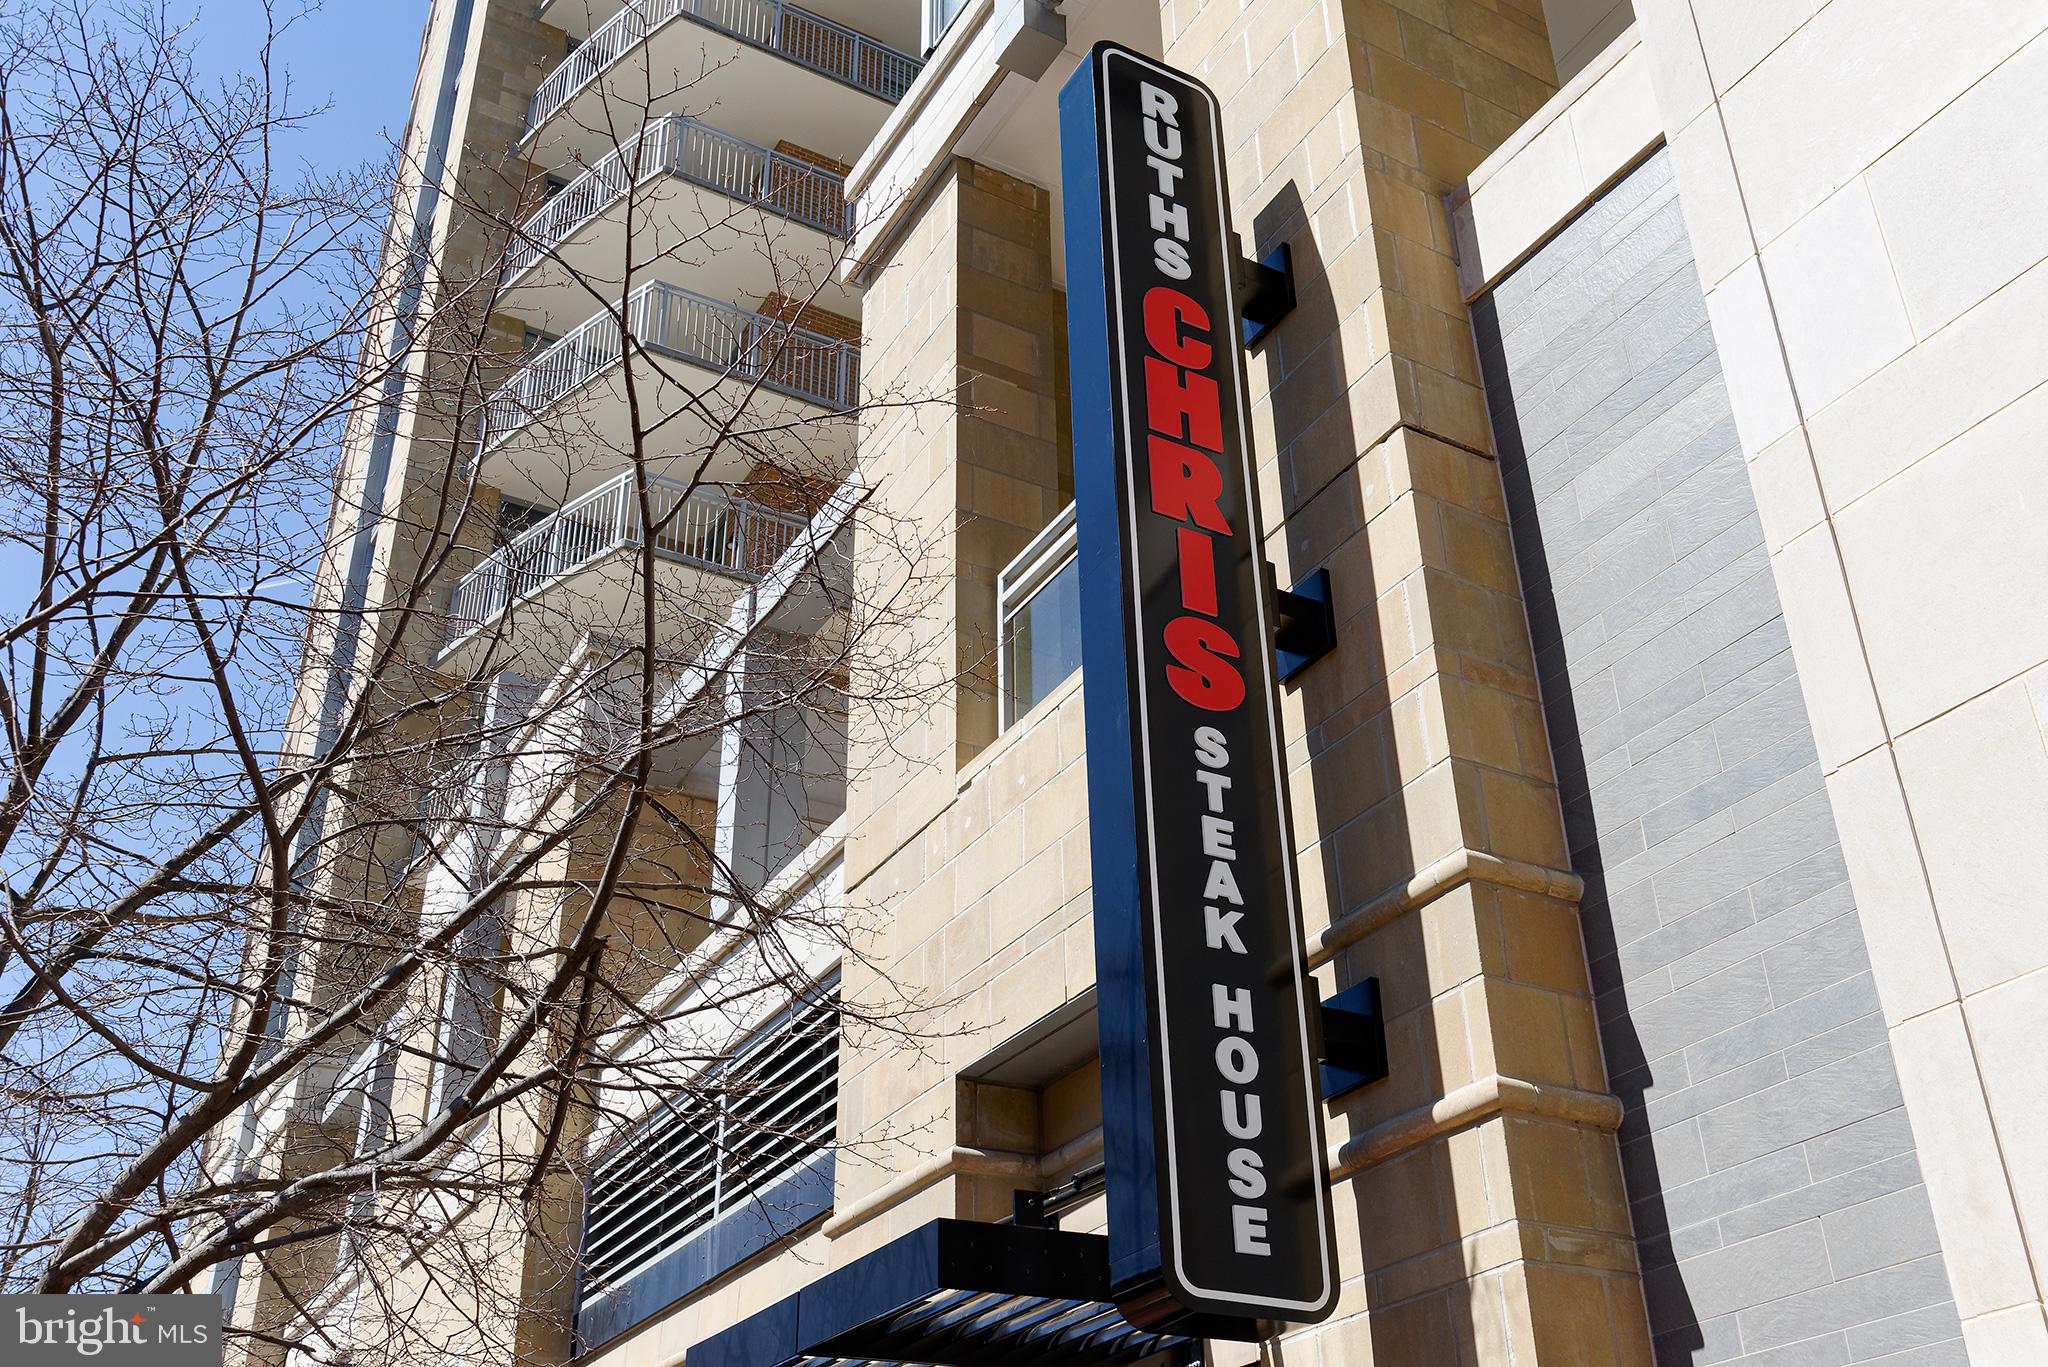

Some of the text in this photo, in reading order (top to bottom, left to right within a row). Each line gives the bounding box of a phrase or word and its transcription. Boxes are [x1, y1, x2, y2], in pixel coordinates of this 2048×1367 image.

[1140, 80, 1272, 1257] RUTHS CHRIS STEAK HOUSE
